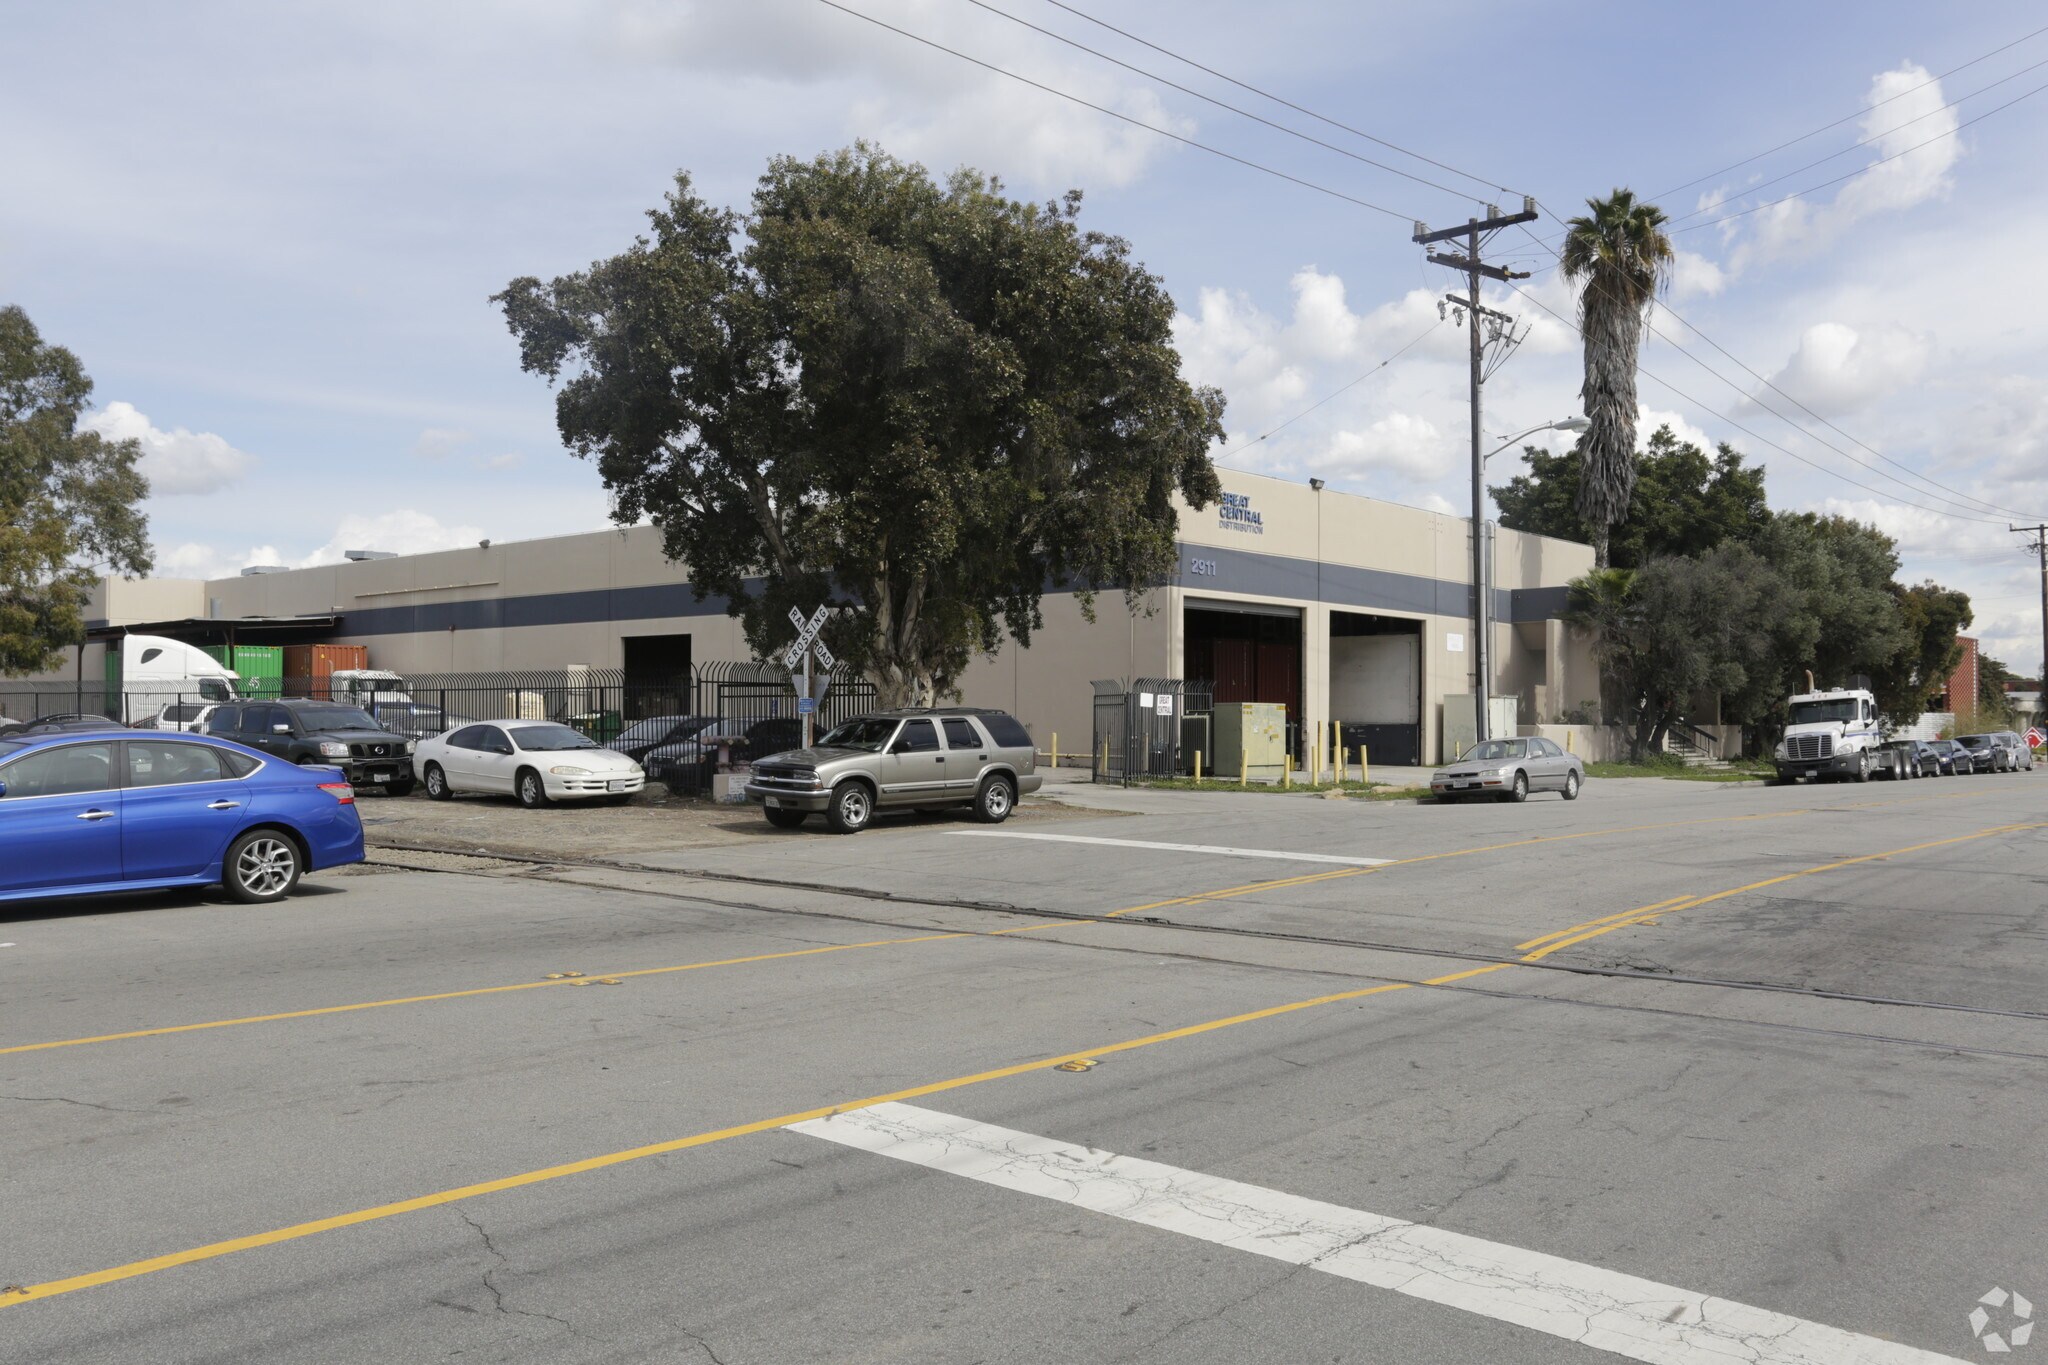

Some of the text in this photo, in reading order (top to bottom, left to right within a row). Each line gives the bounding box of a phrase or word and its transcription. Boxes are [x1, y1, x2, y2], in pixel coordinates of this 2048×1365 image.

[1220, 505, 1263, 525] CENTRAL
[1219, 520, 1263, 535] DISTRIBUTION
[1191, 558, 1216, 576] 2911
[787, 608, 826, 665] CROSSING
[814, 639, 832, 666] ROAD
